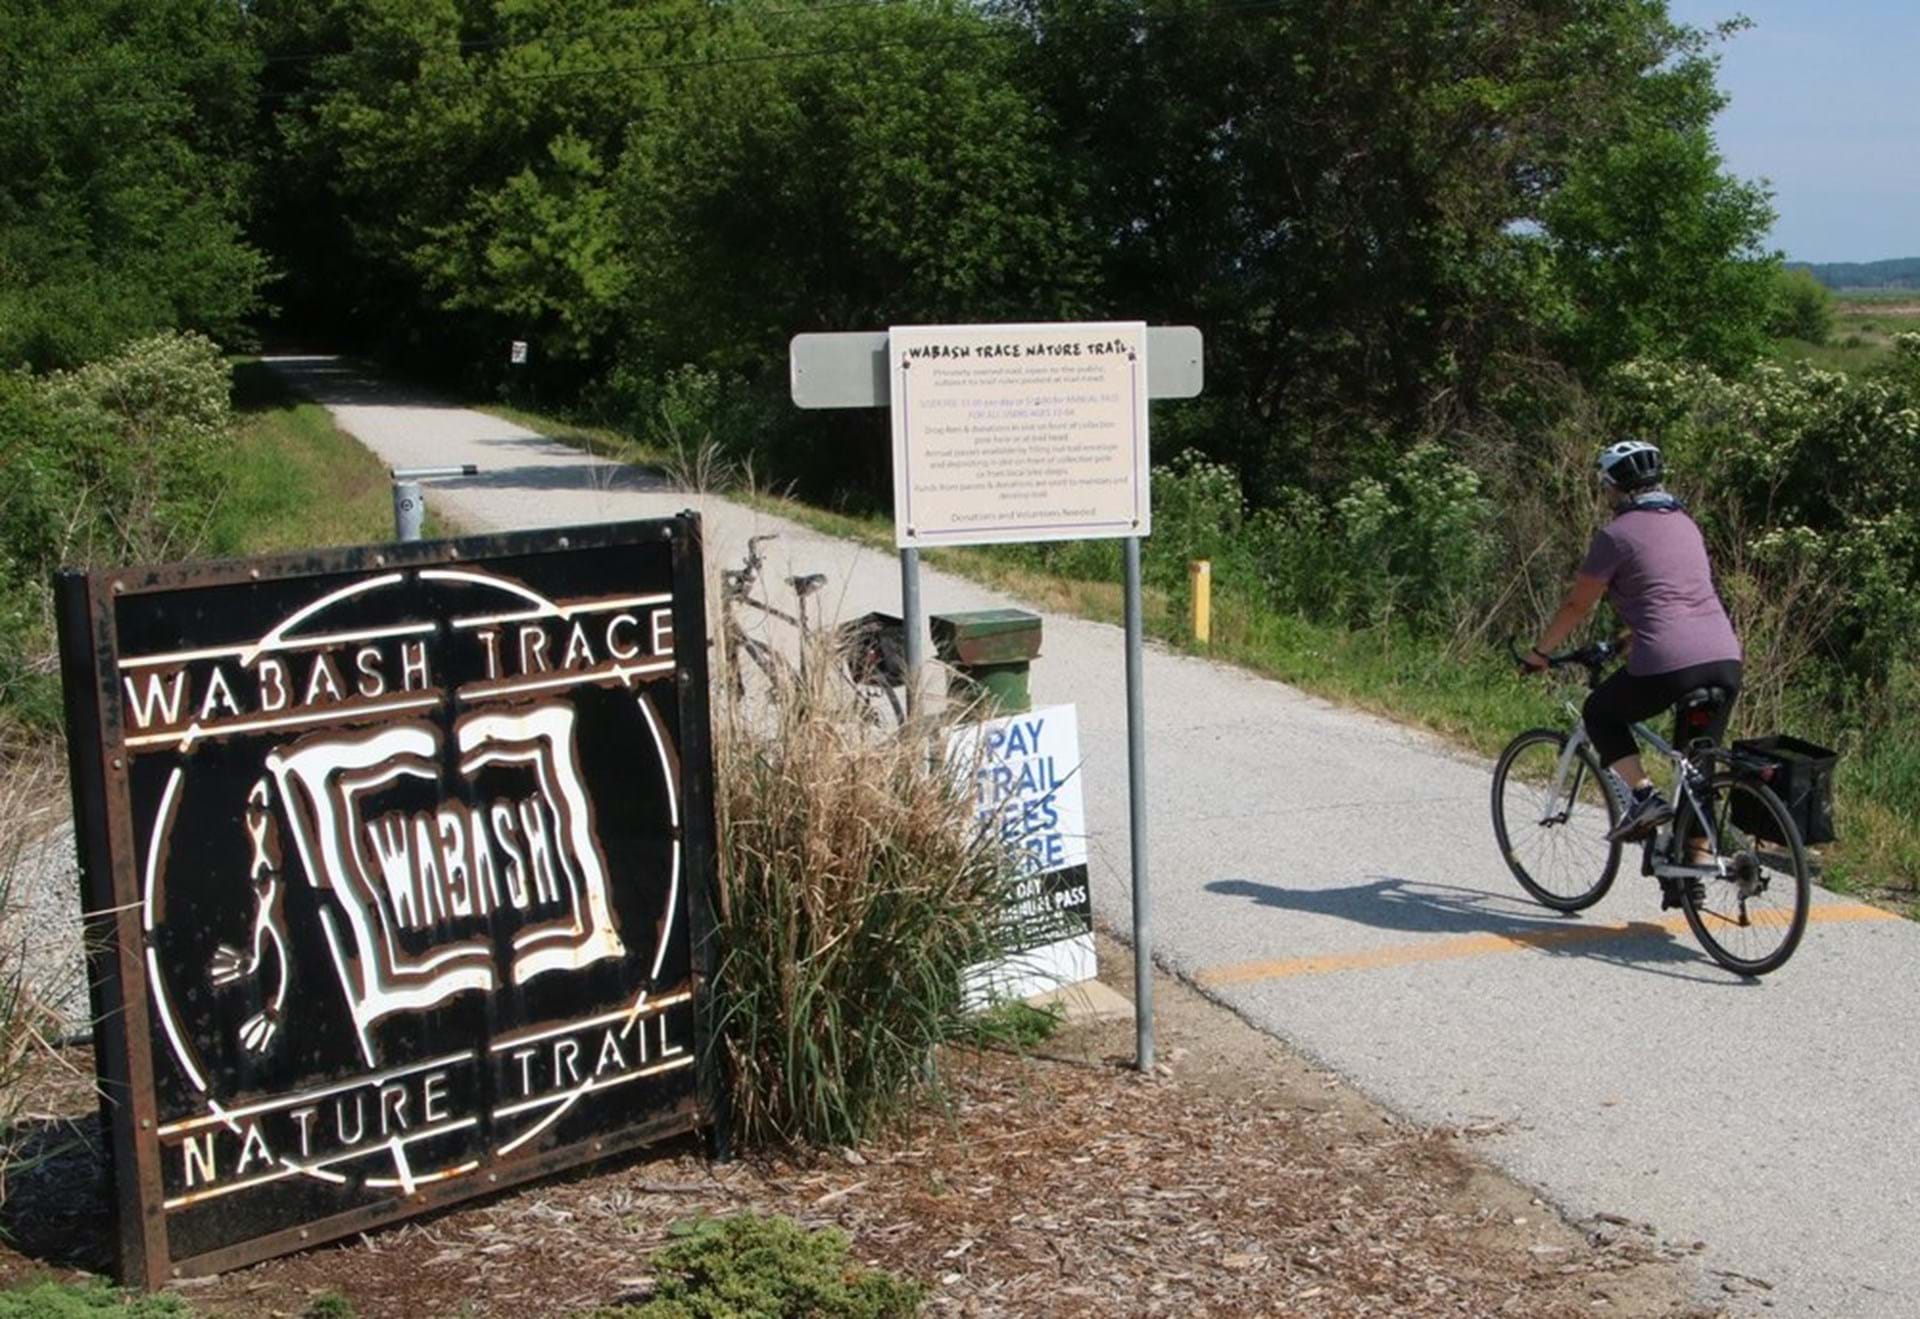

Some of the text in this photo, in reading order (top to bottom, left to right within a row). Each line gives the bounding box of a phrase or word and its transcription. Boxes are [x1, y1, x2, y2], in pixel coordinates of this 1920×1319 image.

[908, 344, 971, 360] WABASH
[975, 343, 1020, 358] TRACE
[1026, 342, 1082, 356] NATURE
[123, 609, 674, 729] WABASH TRACE
[985, 719, 1045, 762] PAY
[977, 756, 1063, 804] TRAIL
[366, 799, 565, 929] WABASH
[1055, 886, 1087, 910] PASS
[183, 1013, 684, 1187] NATURE TRAIL
